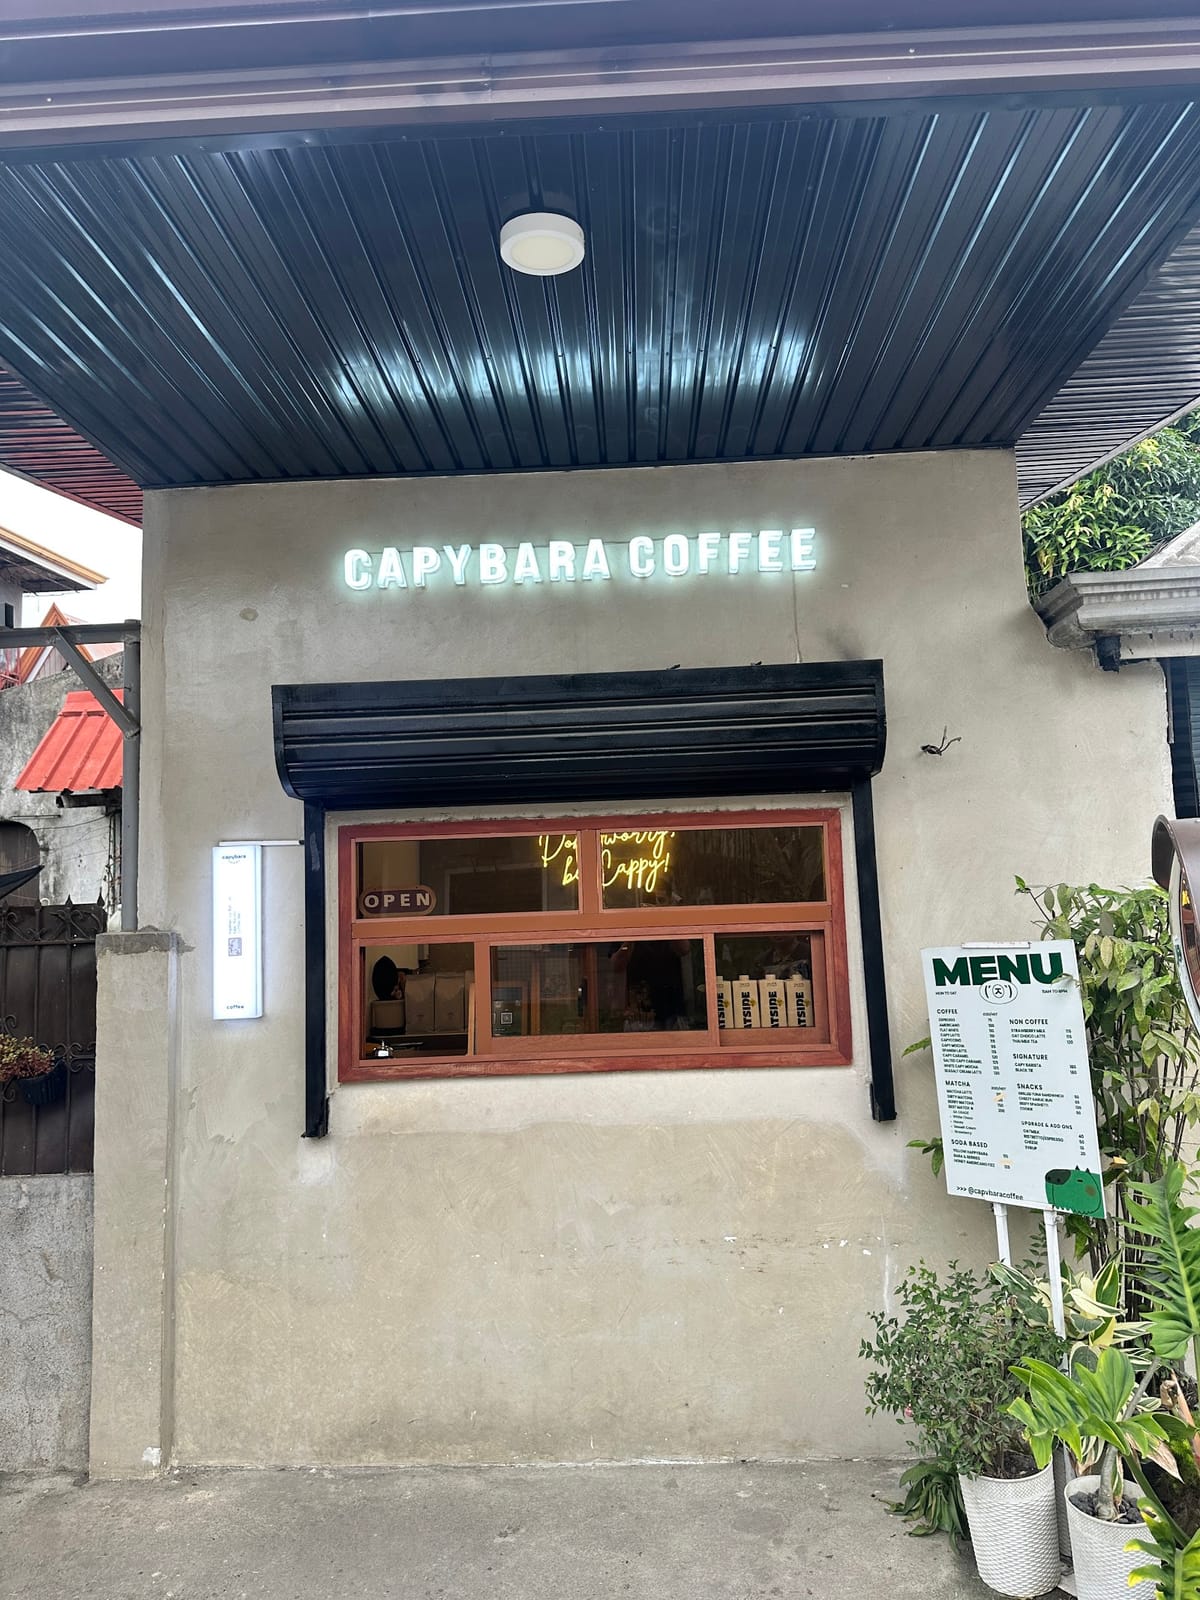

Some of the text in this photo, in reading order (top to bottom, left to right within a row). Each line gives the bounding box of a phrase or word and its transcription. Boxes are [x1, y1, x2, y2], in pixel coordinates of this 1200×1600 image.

[344, 528, 816, 590] CAPYBARA COFFEE
[601, 849, 670, 893] Cappy!
[364, 893, 430, 908] OPEN
[932, 952, 1063, 986] MENU
[741, 991, 752, 1028] ATSIDE
[768, 991, 779, 1028] ATSIDE
[1012, 1053, 1048, 1061] SIGNATURE
[1021, 1120, 1044, 1128] UPGRADE
[968, 1140, 988, 1148] BASED
[968, 1186, 1024, 1200] @capybaracoffee
